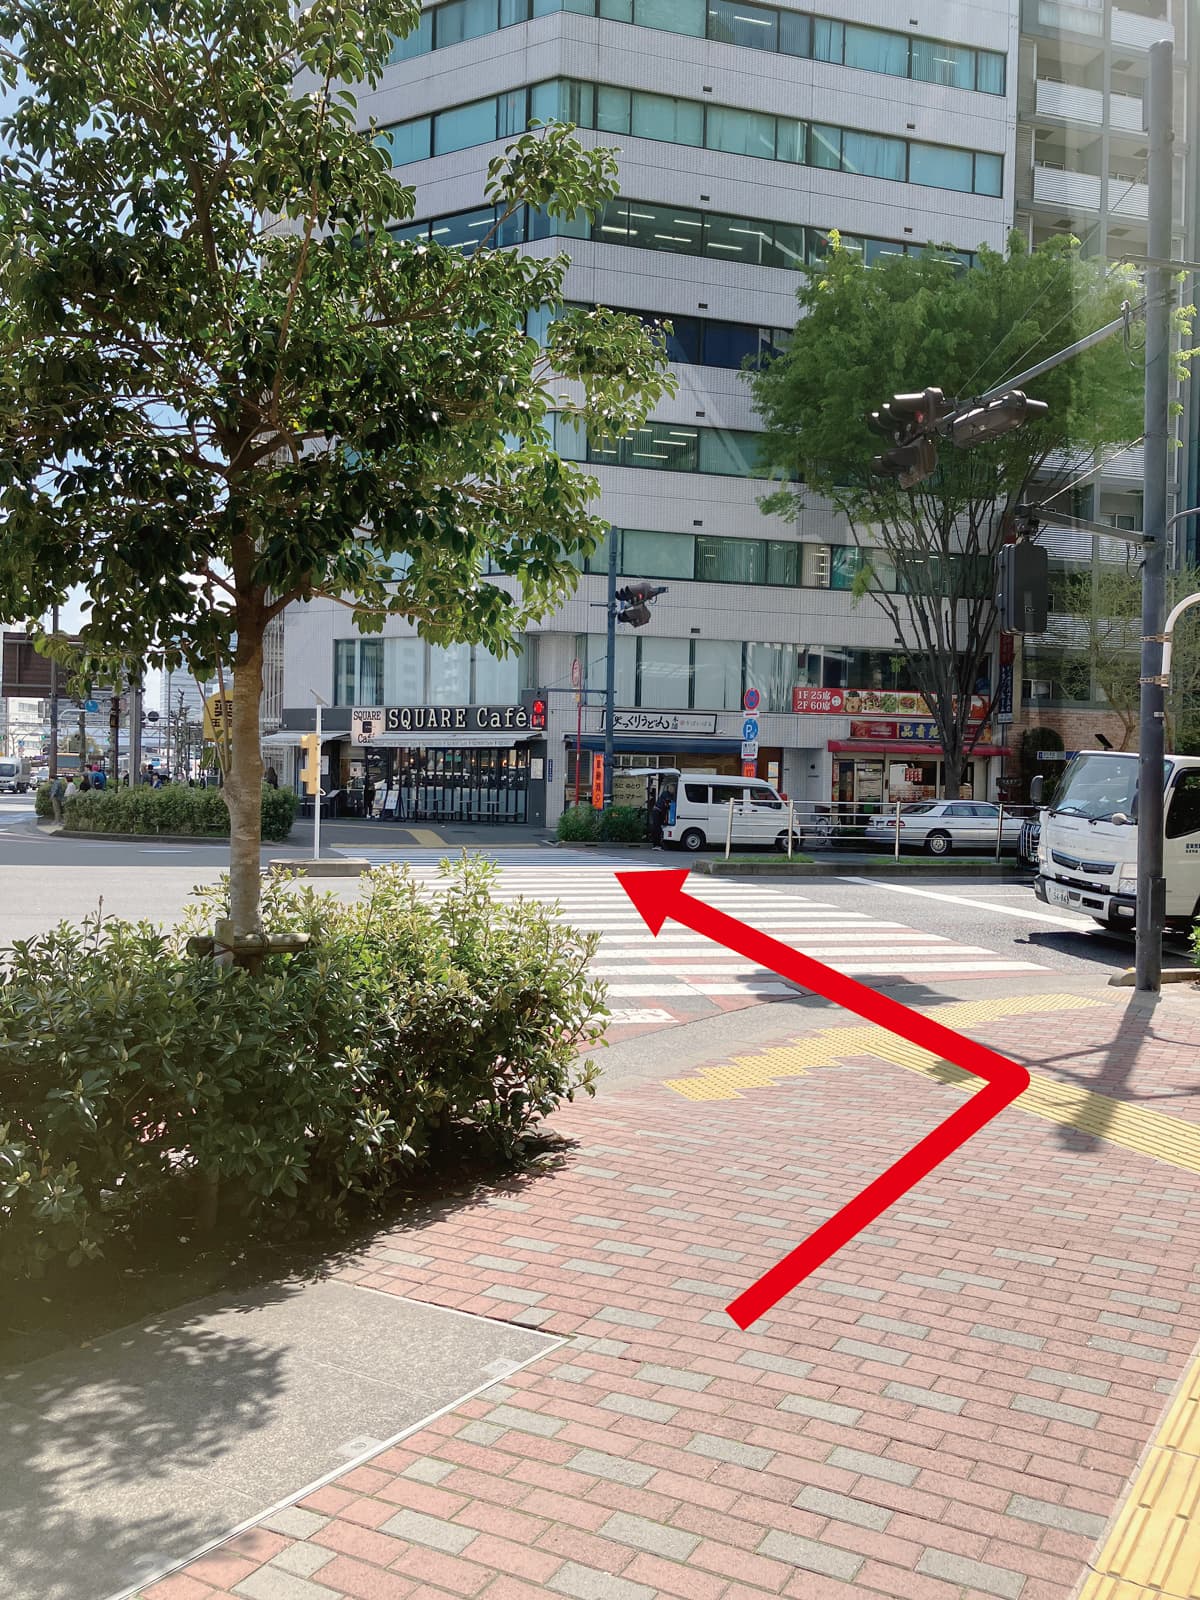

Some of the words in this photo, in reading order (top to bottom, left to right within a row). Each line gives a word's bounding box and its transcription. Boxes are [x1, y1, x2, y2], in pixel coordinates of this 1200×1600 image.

[797, 701, 809, 710] 2F
[353, 710, 382, 721] SQUARE
[388, 708, 466, 730] SQUARE
[476, 707, 527, 728] Café
